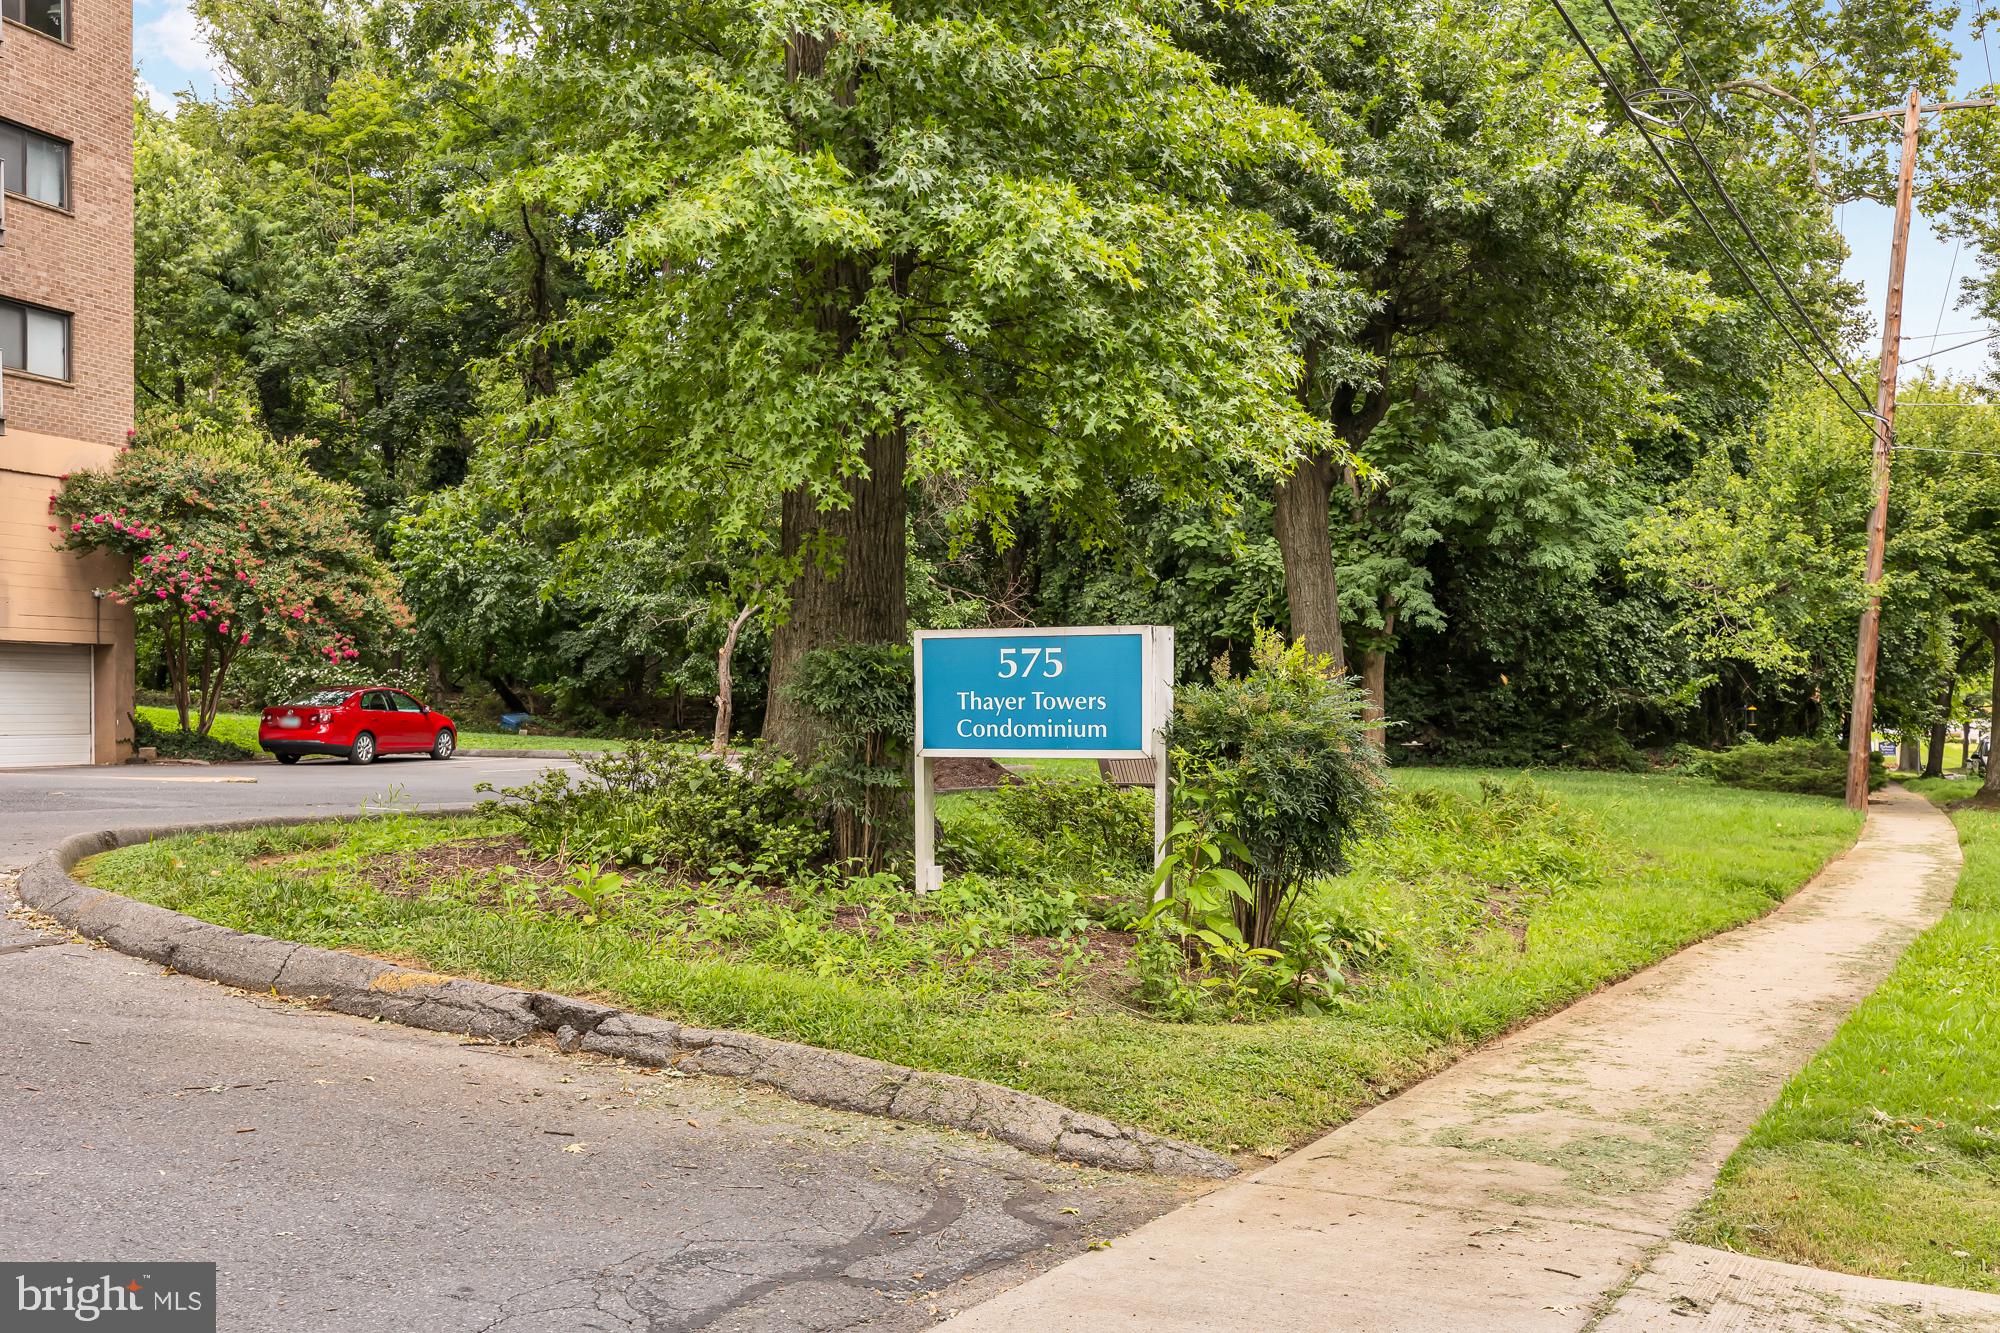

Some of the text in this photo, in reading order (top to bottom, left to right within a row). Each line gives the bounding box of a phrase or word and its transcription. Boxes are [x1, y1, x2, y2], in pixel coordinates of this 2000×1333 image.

[997, 647, 1063, 679] 575
[956, 690, 1107, 717] Thayer Towers
[956, 718, 1107, 739] Condominium
